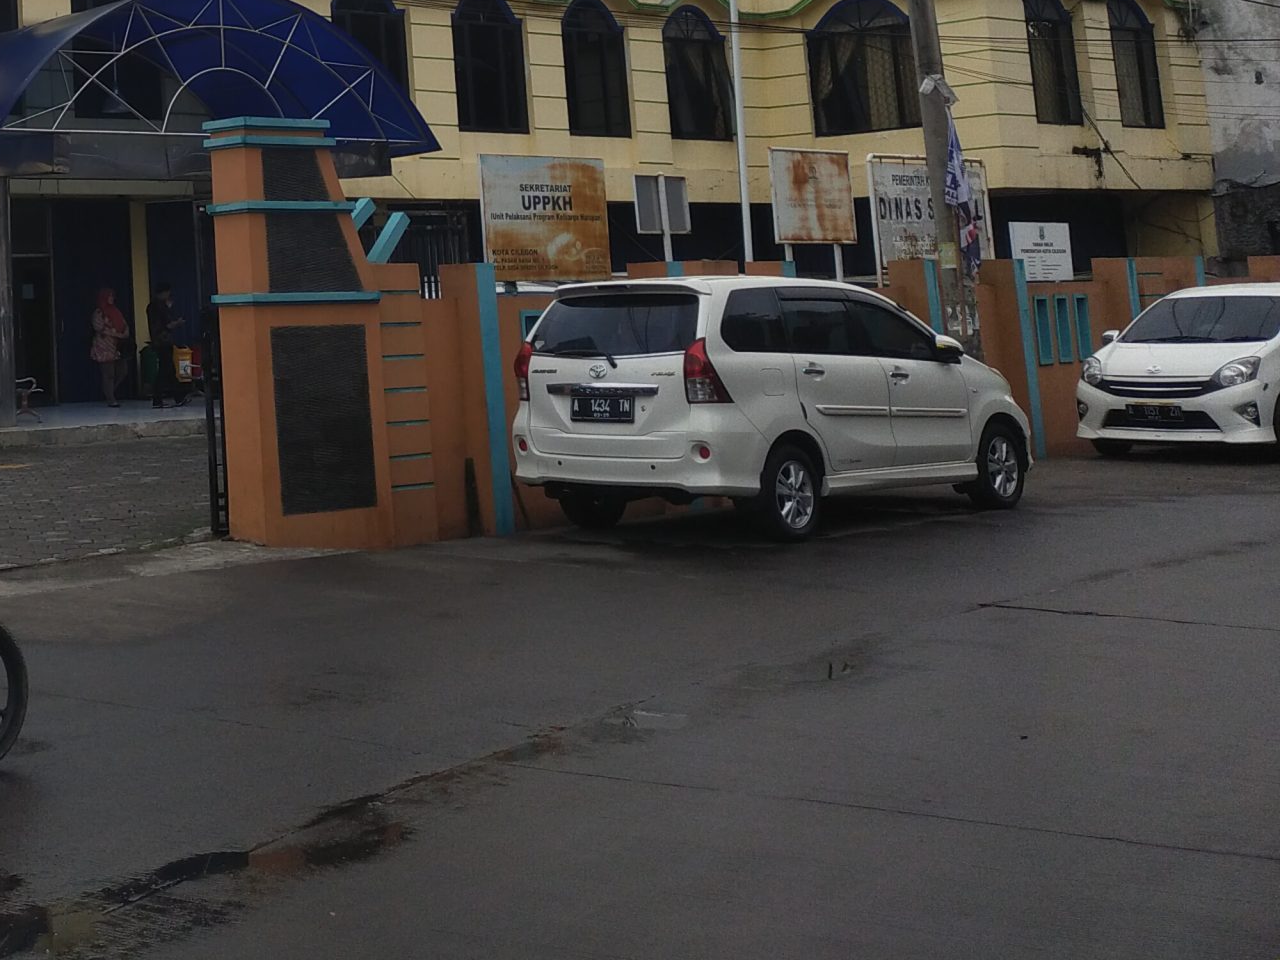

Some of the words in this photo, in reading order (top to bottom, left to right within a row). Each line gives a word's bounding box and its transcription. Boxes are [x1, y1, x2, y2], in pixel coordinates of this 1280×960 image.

[520, 184, 573, 193] SEKRETARIAT
[521, 195, 573, 211] UPPKH
[879, 196, 921, 220] DINAS
[505, 212, 532, 221] Pelaksana
[533, 213, 555, 222] Program
[573, 398, 580, 411] A
[590, 398, 610, 412] 1434
[618, 399, 630, 412] TN
